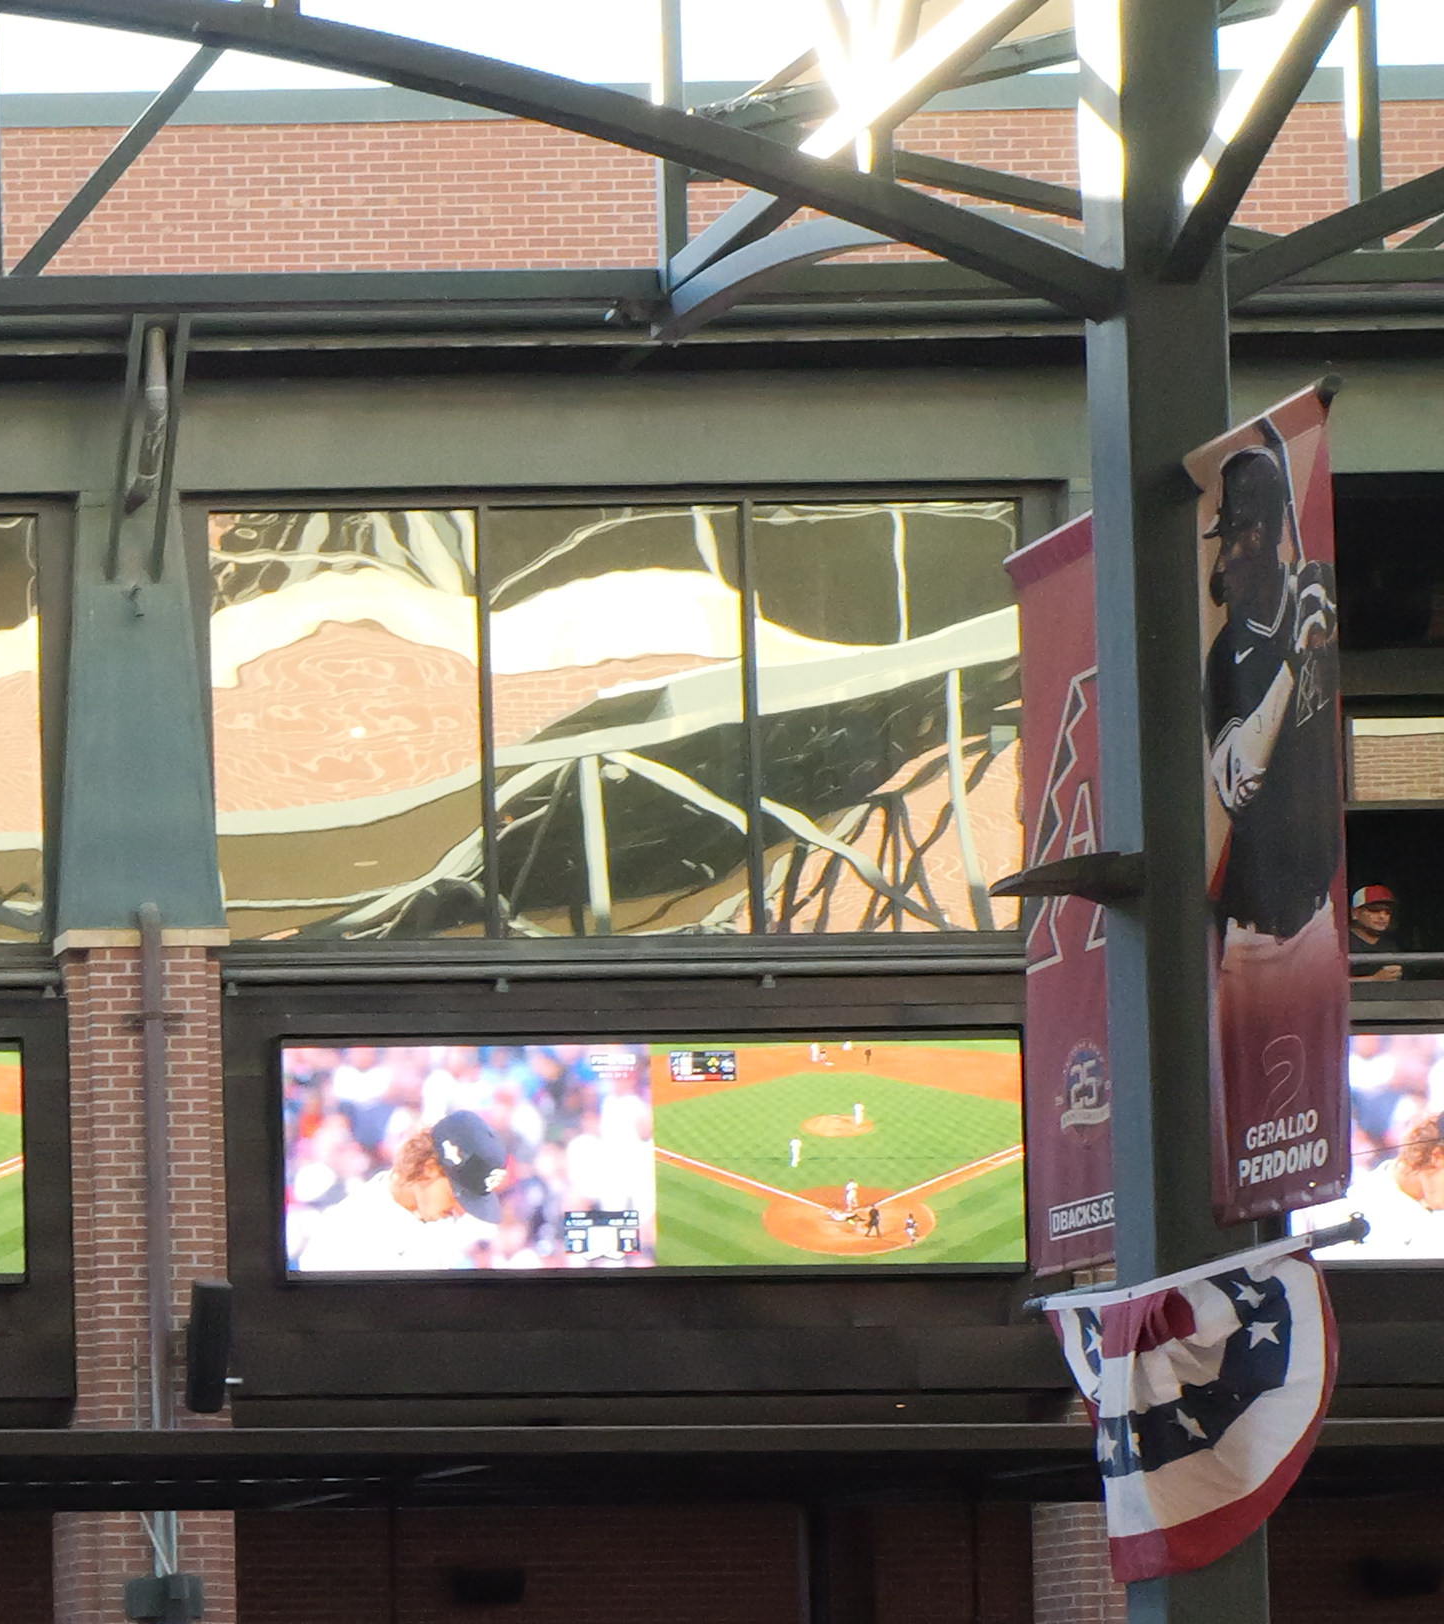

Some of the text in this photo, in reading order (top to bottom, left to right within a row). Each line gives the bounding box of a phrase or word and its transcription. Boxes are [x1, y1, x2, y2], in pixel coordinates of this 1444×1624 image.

[1070, 1059, 1100, 1109] 25
[1246, 1108, 1319, 1151] GERALDO
[1238, 1137, 1329, 1187] PERDOMO
